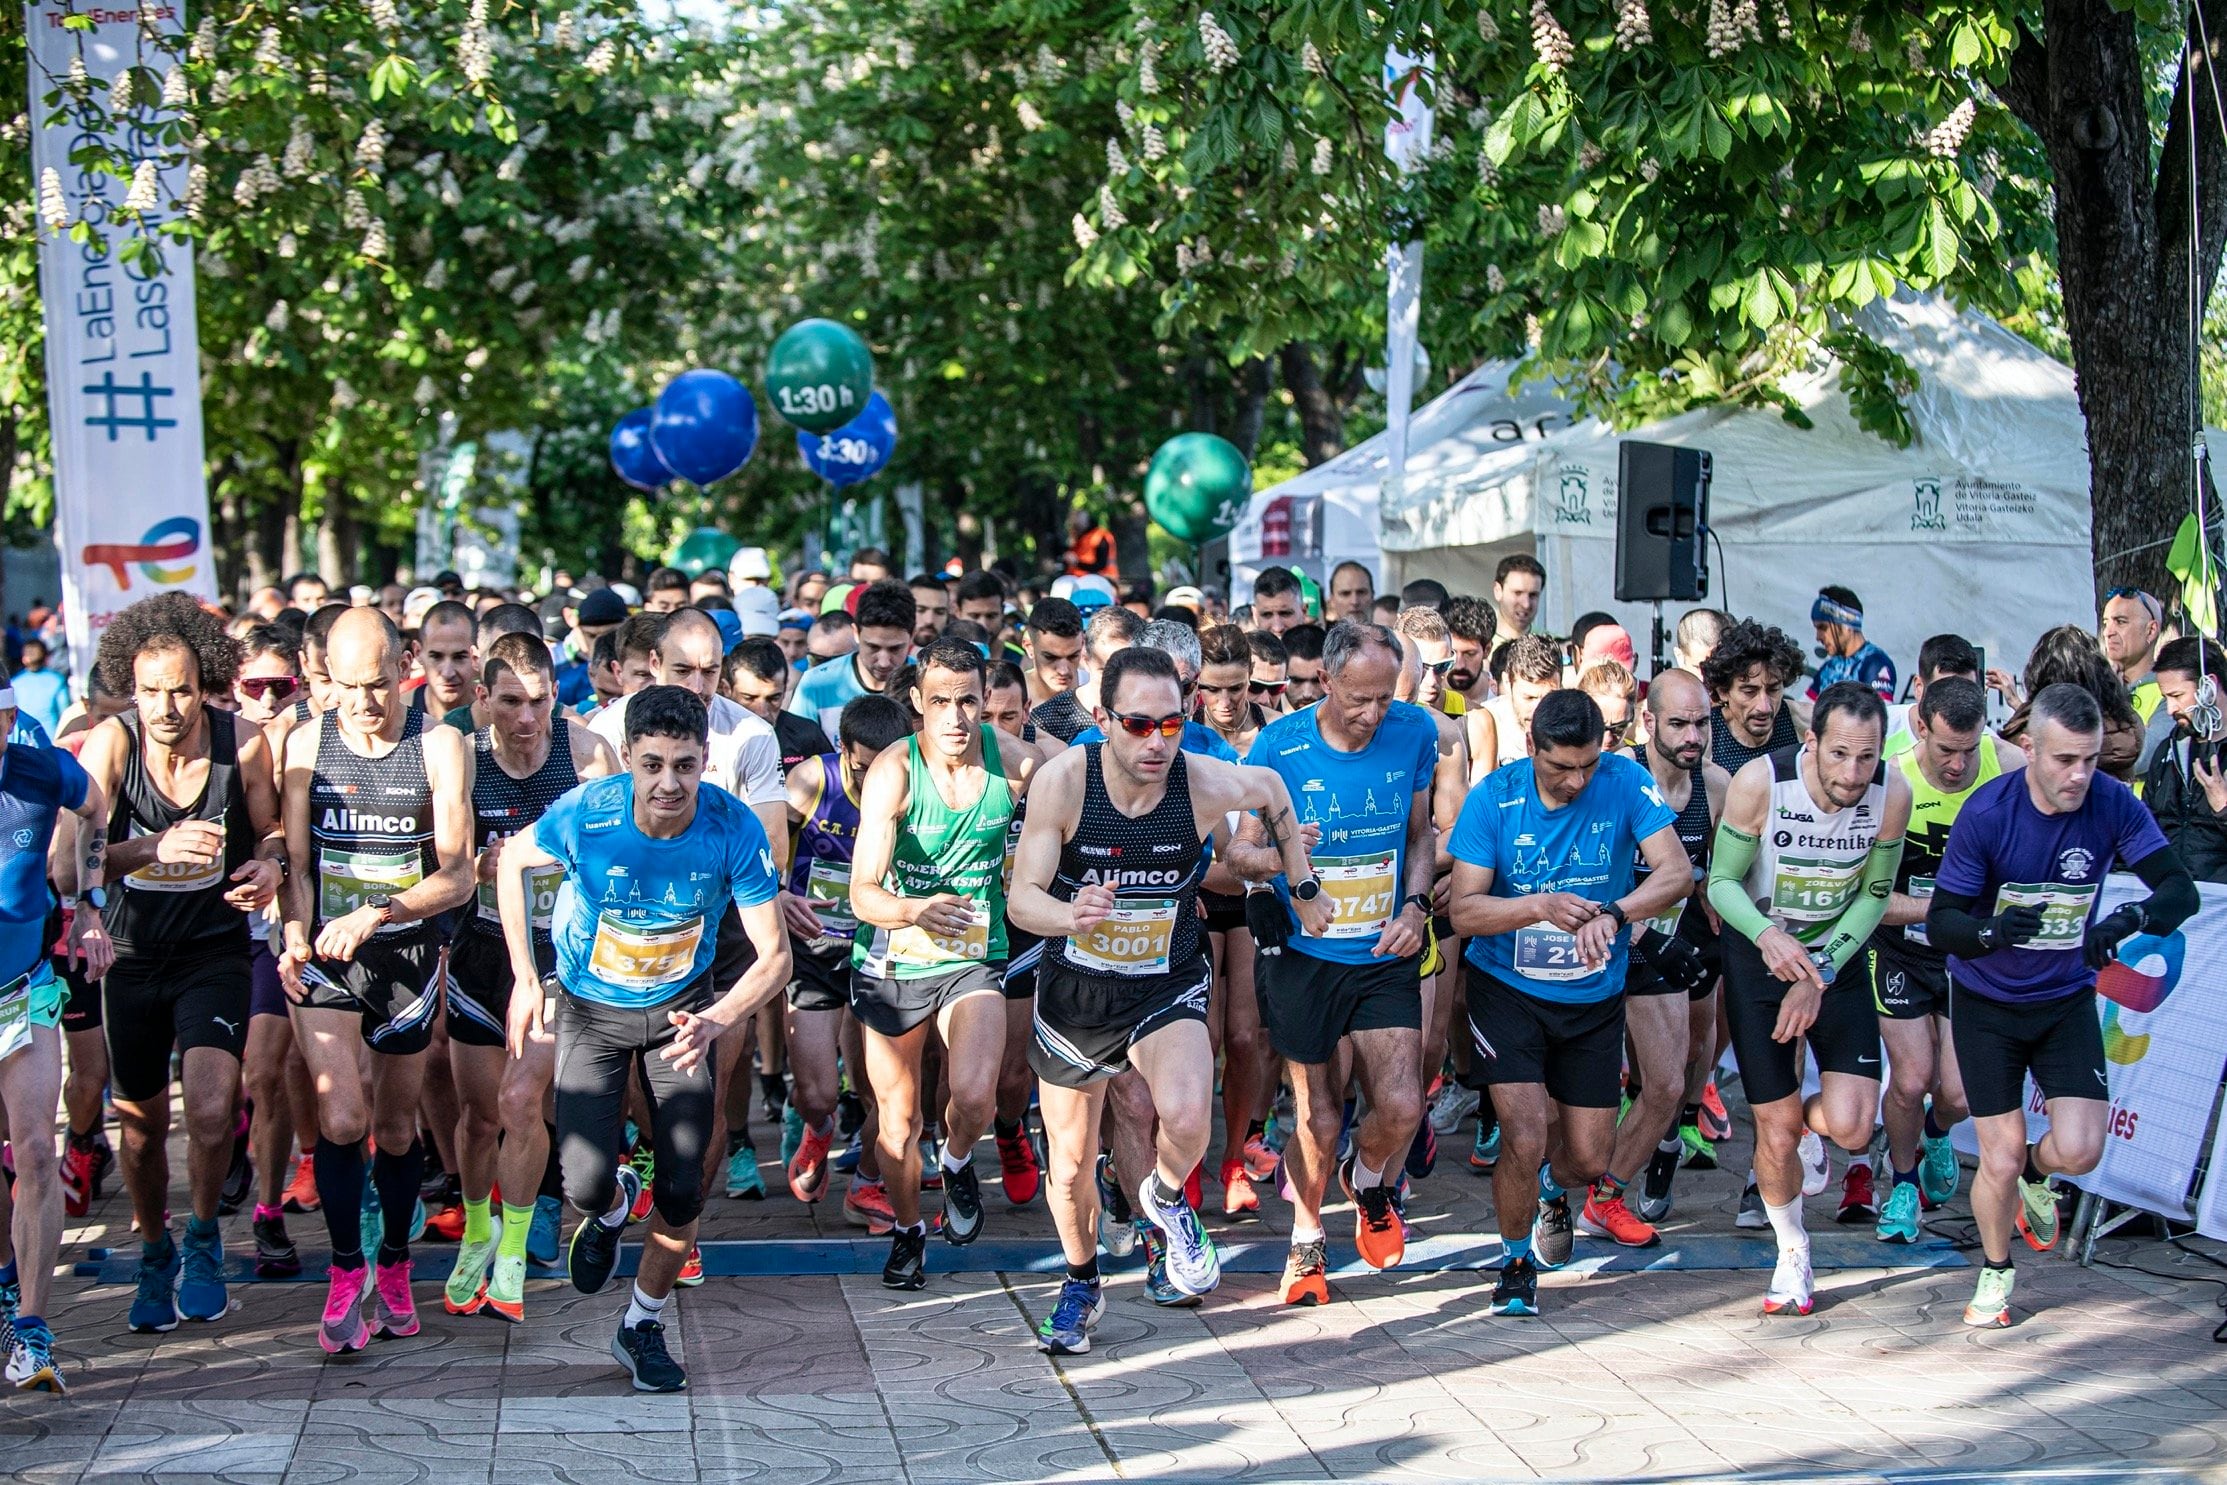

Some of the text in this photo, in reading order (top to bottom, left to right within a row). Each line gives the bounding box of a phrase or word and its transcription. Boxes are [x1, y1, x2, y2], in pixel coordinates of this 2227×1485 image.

[778, 384, 836, 414] 1:30
[816, 435, 868, 465] 3:30
[1955, 479, 2021, 491] Ayuntamiento
[1955, 491, 1967, 499] de
[1956, 514, 1983, 523] Udala
[322, 808, 416, 833] Alimco
[1081, 868, 1180, 885] Alimco
[1113, 925, 1150, 933] PABLO
[1092, 933, 1166, 956] 3001
[1543, 934, 1570, 943] JOSE
